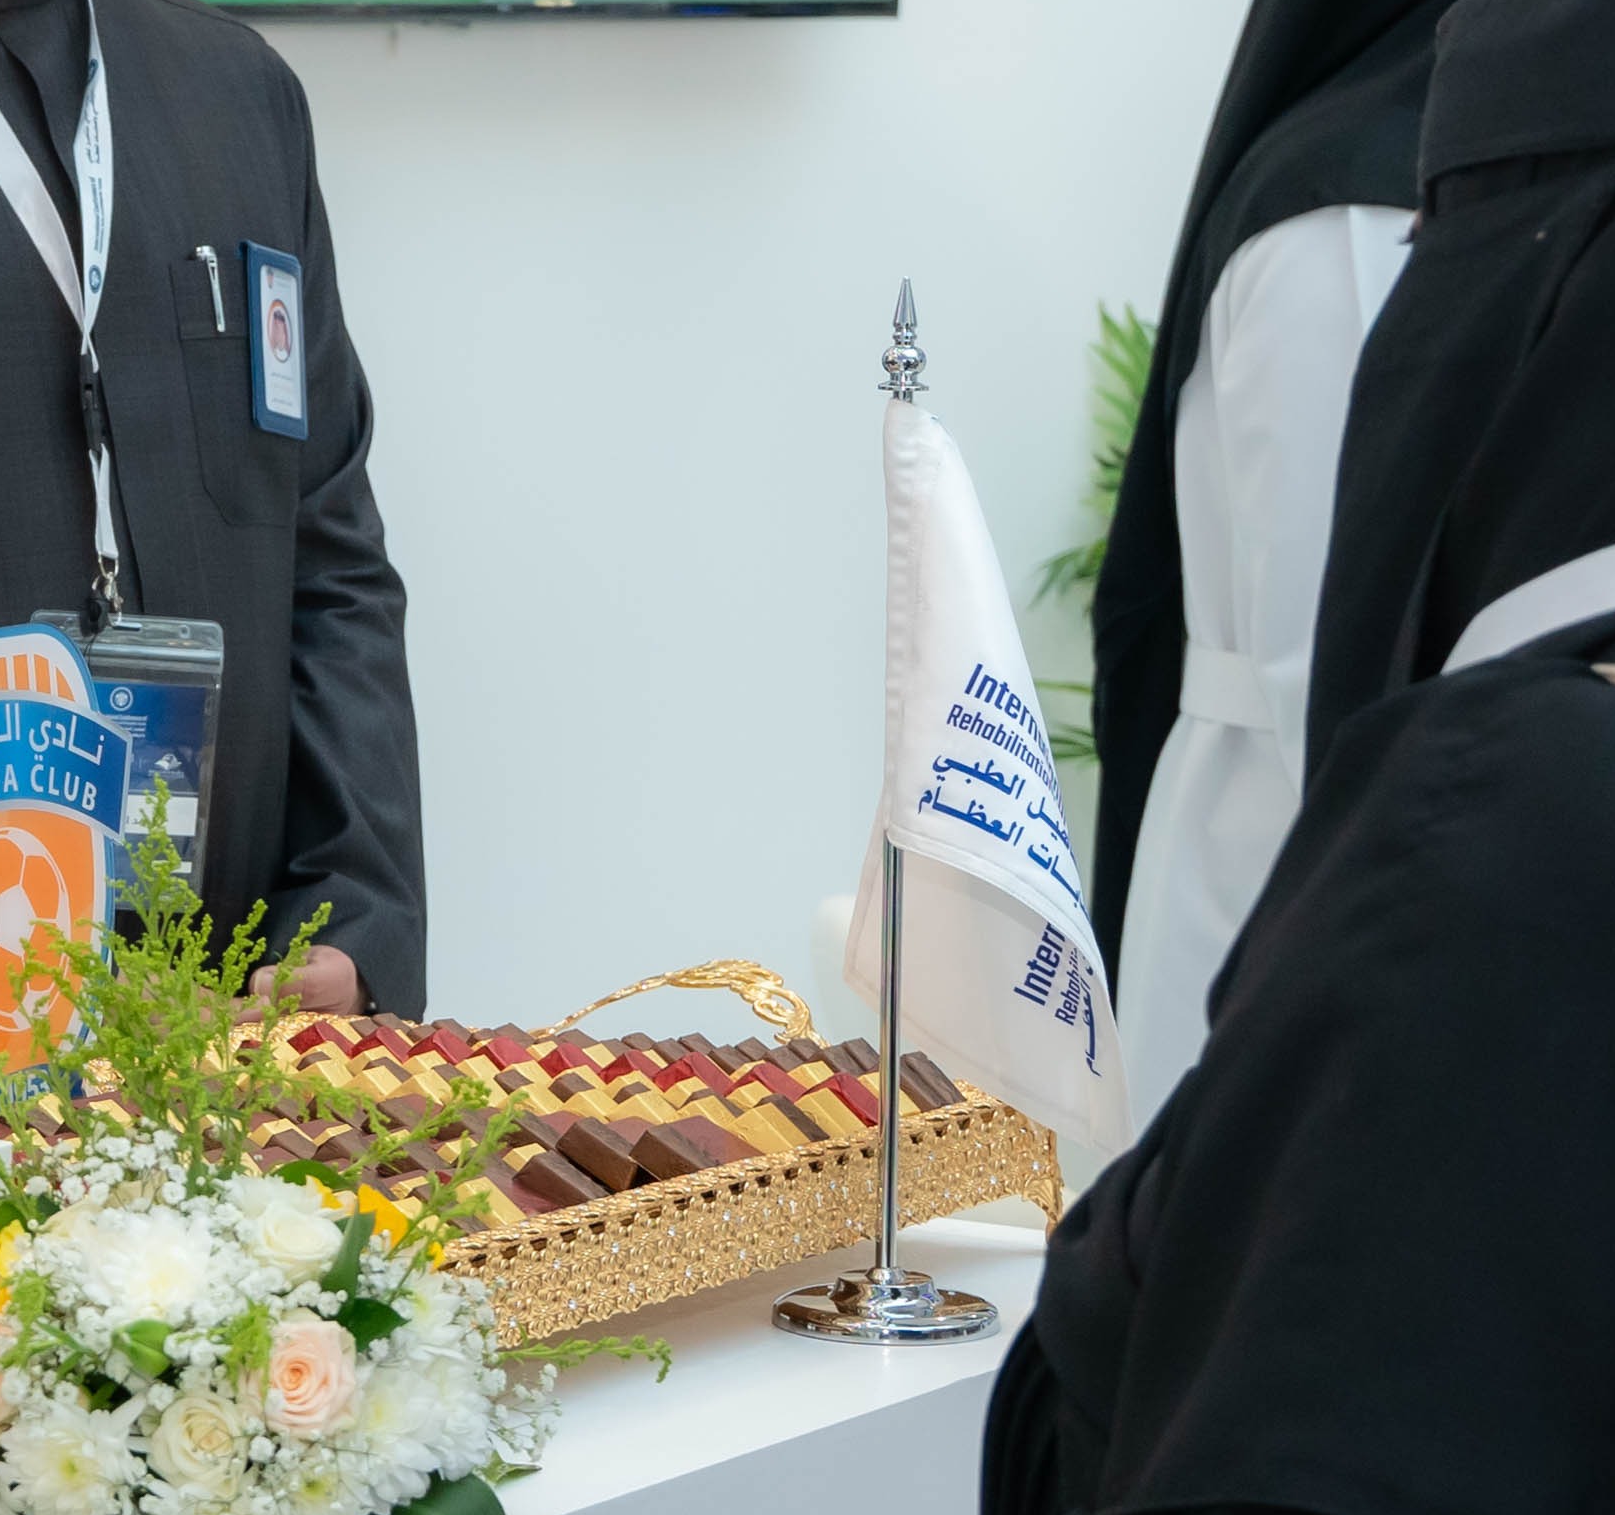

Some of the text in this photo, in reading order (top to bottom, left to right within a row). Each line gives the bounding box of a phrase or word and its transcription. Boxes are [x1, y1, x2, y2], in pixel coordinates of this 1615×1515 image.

[29, 714, 105, 766] نادي
[30, 763, 98, 812] CLUB
[932, 752, 1026, 801] الطبي
[918, 786, 1025, 847] العظام
